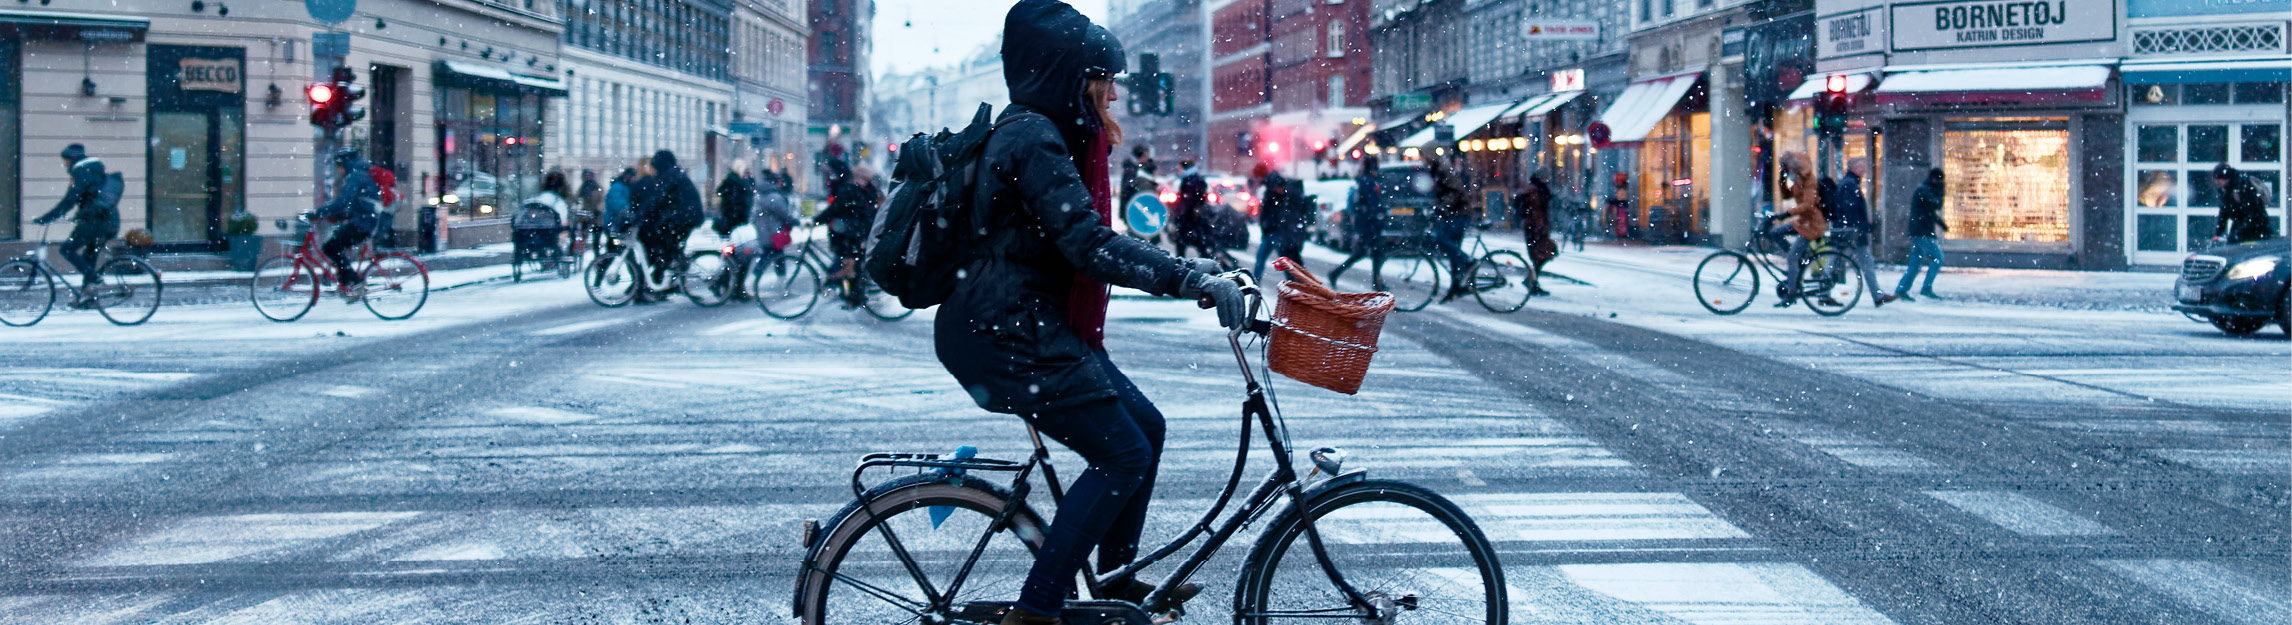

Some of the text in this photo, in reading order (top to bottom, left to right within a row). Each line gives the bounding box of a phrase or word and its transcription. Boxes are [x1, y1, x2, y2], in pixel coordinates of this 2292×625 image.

[1957, 27, 2044, 42] KATRIN DESIGN
[185, 65, 236, 83] BECCO
